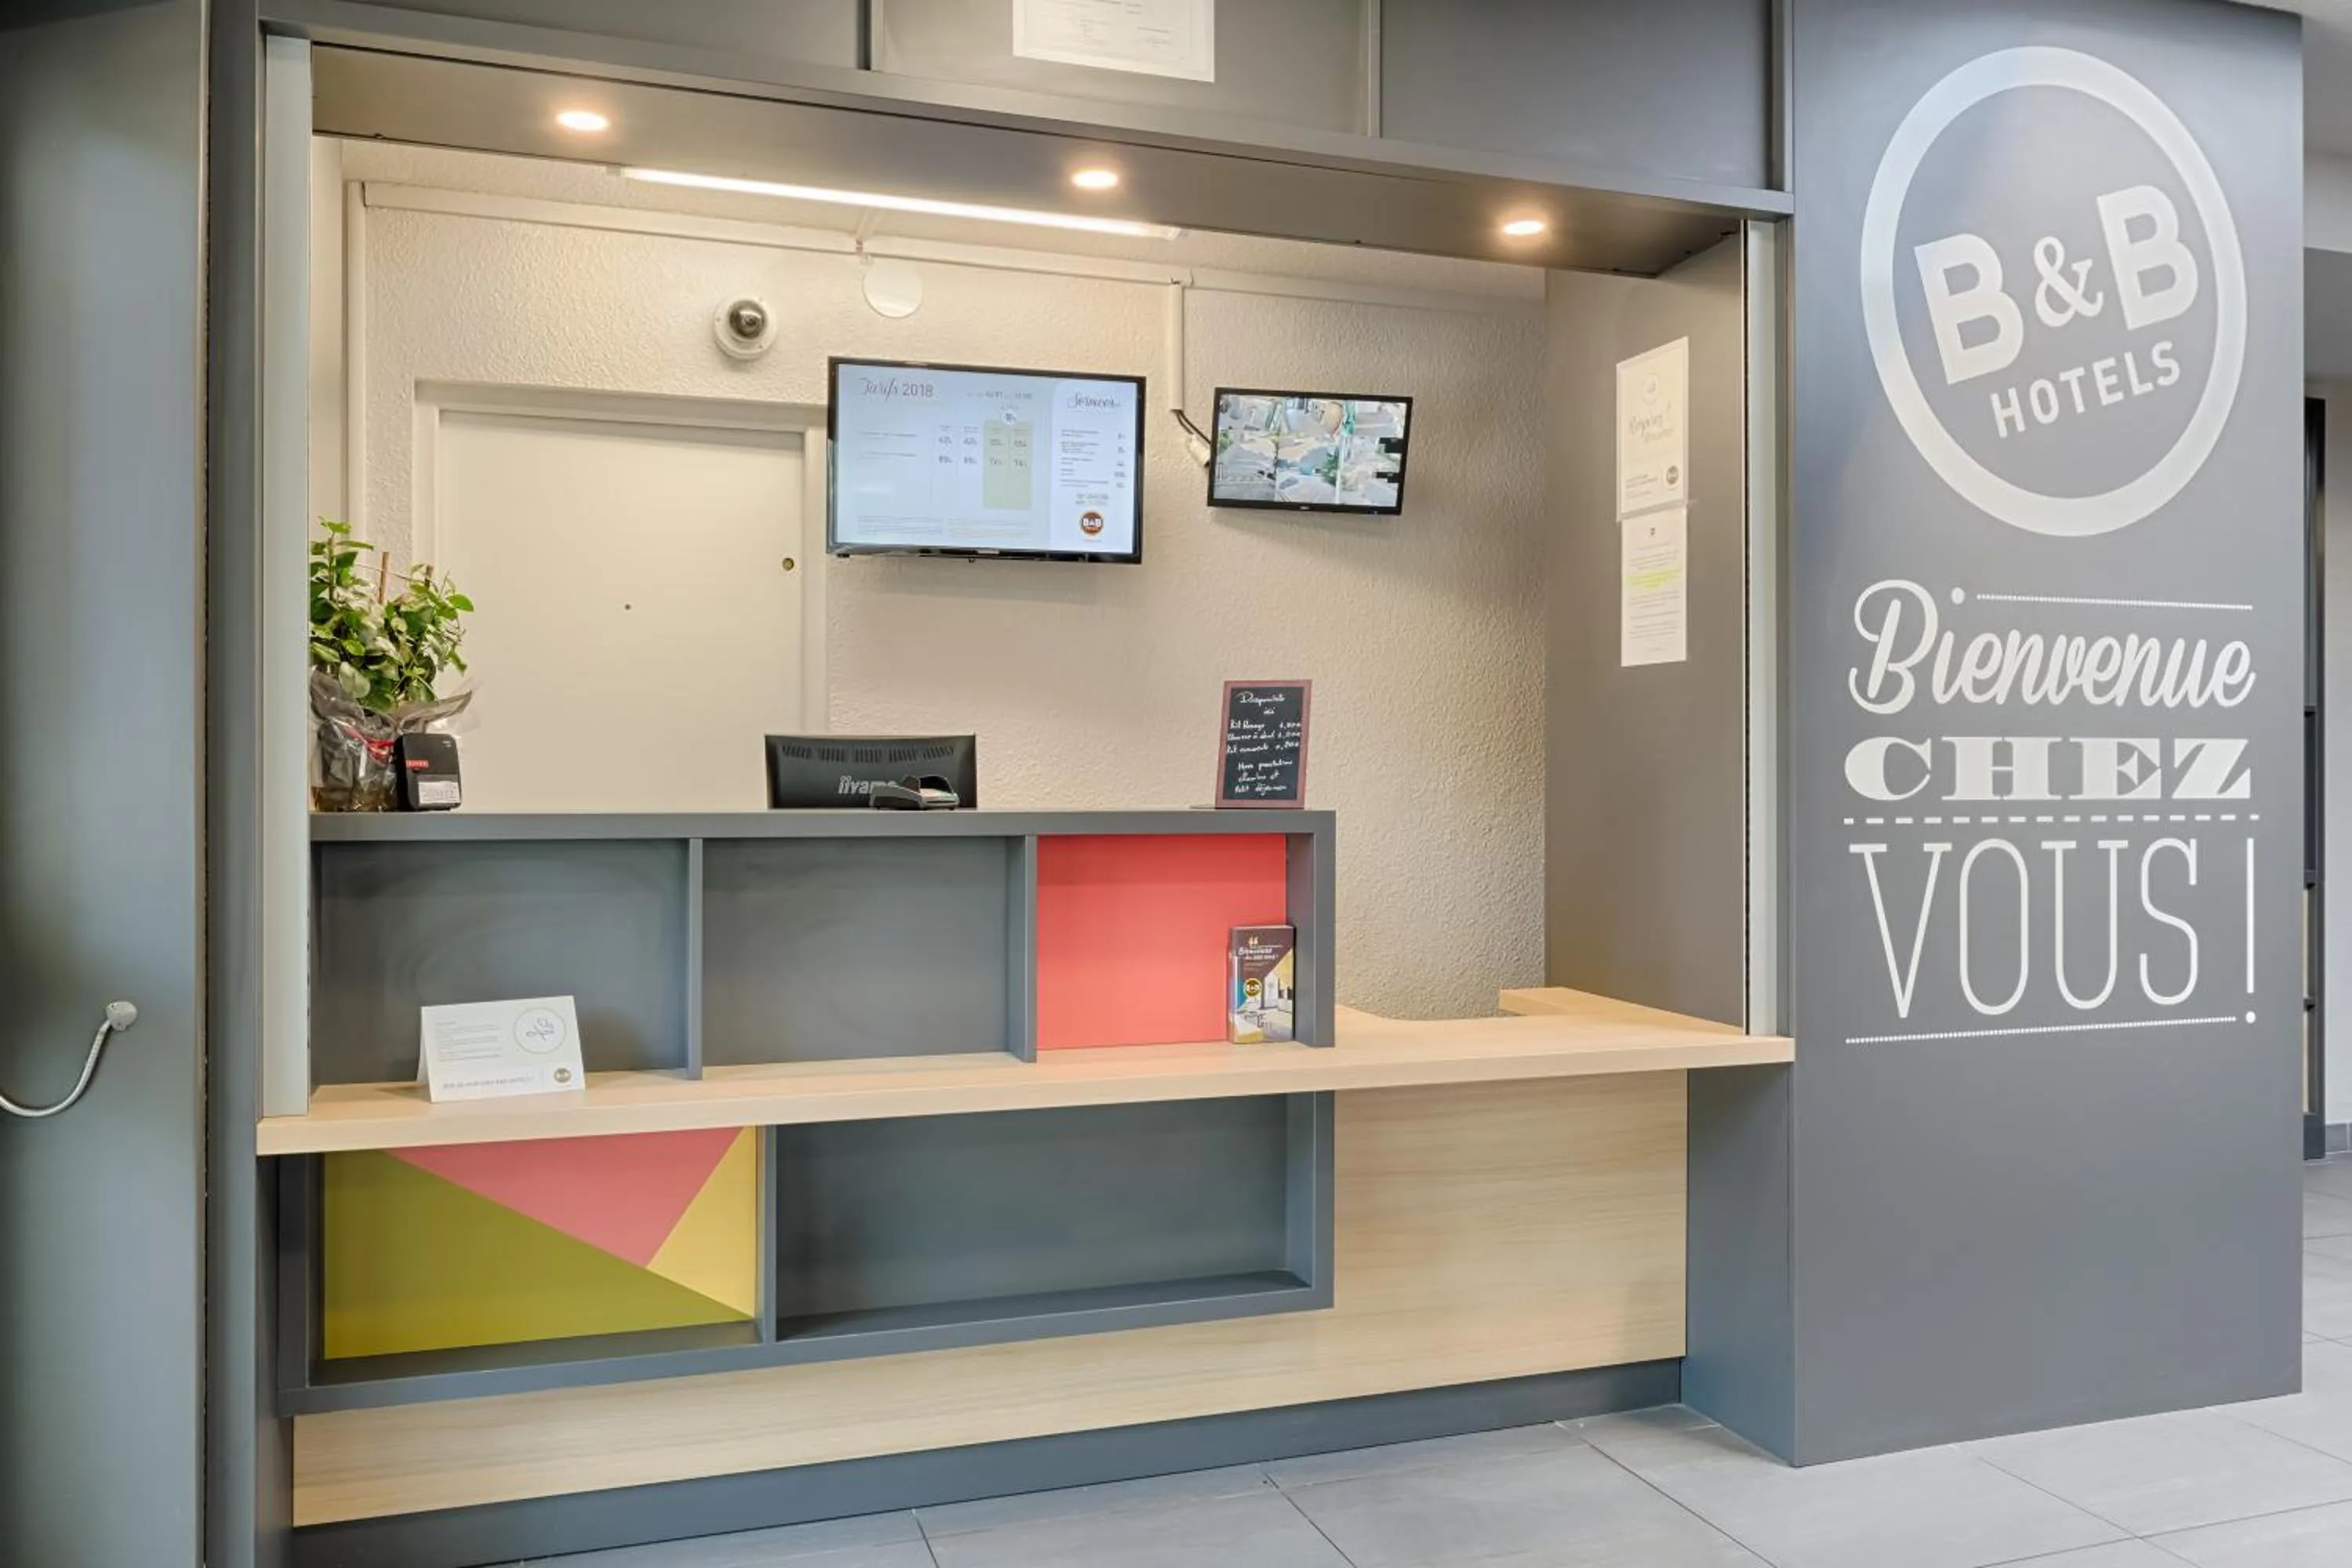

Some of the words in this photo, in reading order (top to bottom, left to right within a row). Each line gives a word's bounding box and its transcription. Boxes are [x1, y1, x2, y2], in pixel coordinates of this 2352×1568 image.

[1914, 185, 2198, 385] B&B
[902, 382, 935, 397] 2018
[1991, 341, 2181, 439] HOTELS
[1849, 579, 2256, 714] Bienvenue
[1844, 736, 2251, 800] CHEZ
